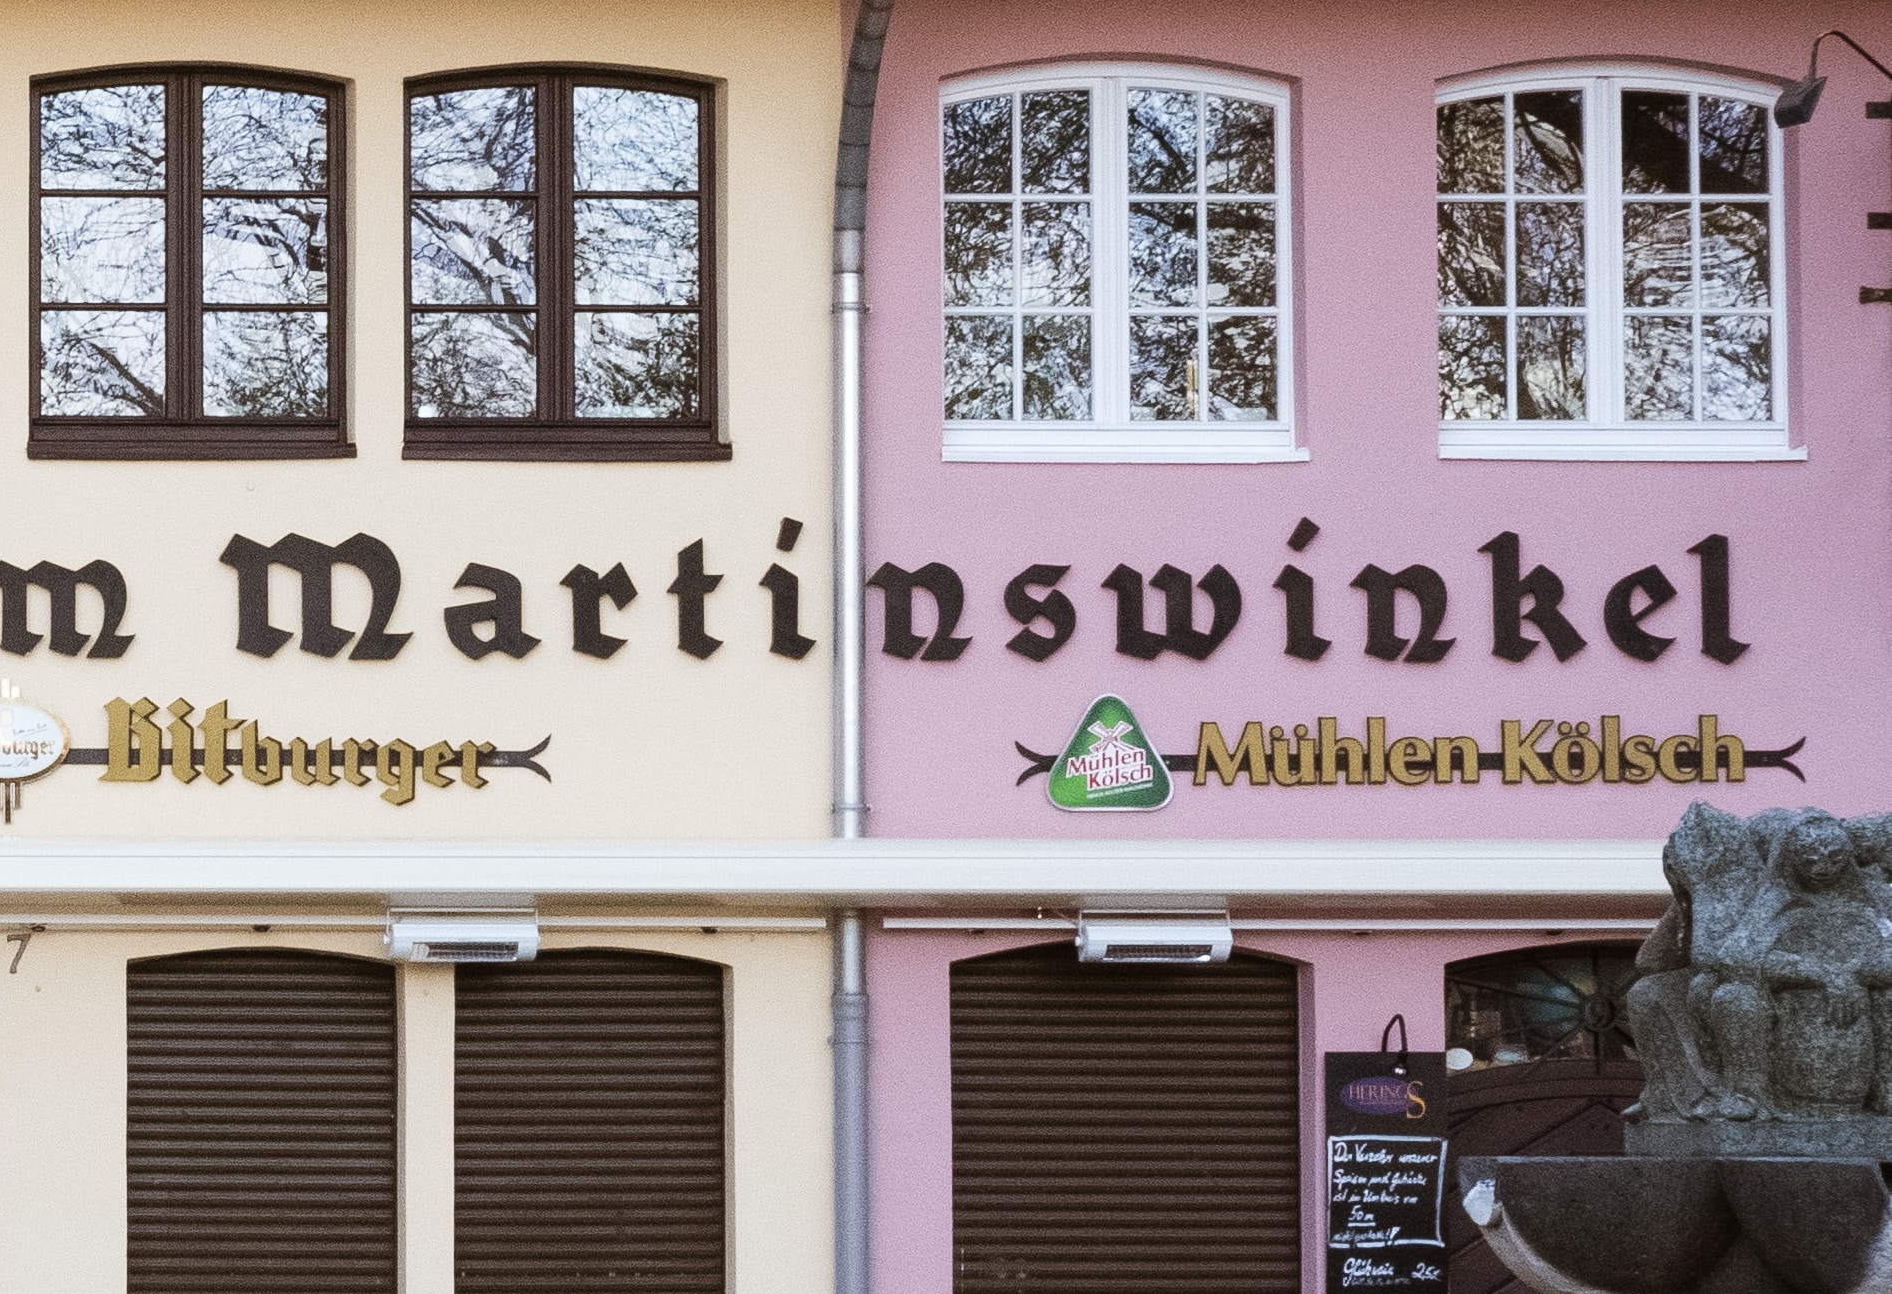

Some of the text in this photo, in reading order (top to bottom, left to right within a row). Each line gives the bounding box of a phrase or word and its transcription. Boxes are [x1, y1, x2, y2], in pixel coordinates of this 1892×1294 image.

[219, 516, 1752, 665] Martinswinkel
[99, 696, 498, 806] Bitburger
[1068, 749, 1144, 777] Mühlen
[1089, 763, 1152, 789] Kölsch
[1193, 712, 1746, 786] Mühlen Kölsch
[6, 932, 32, 974] 7
